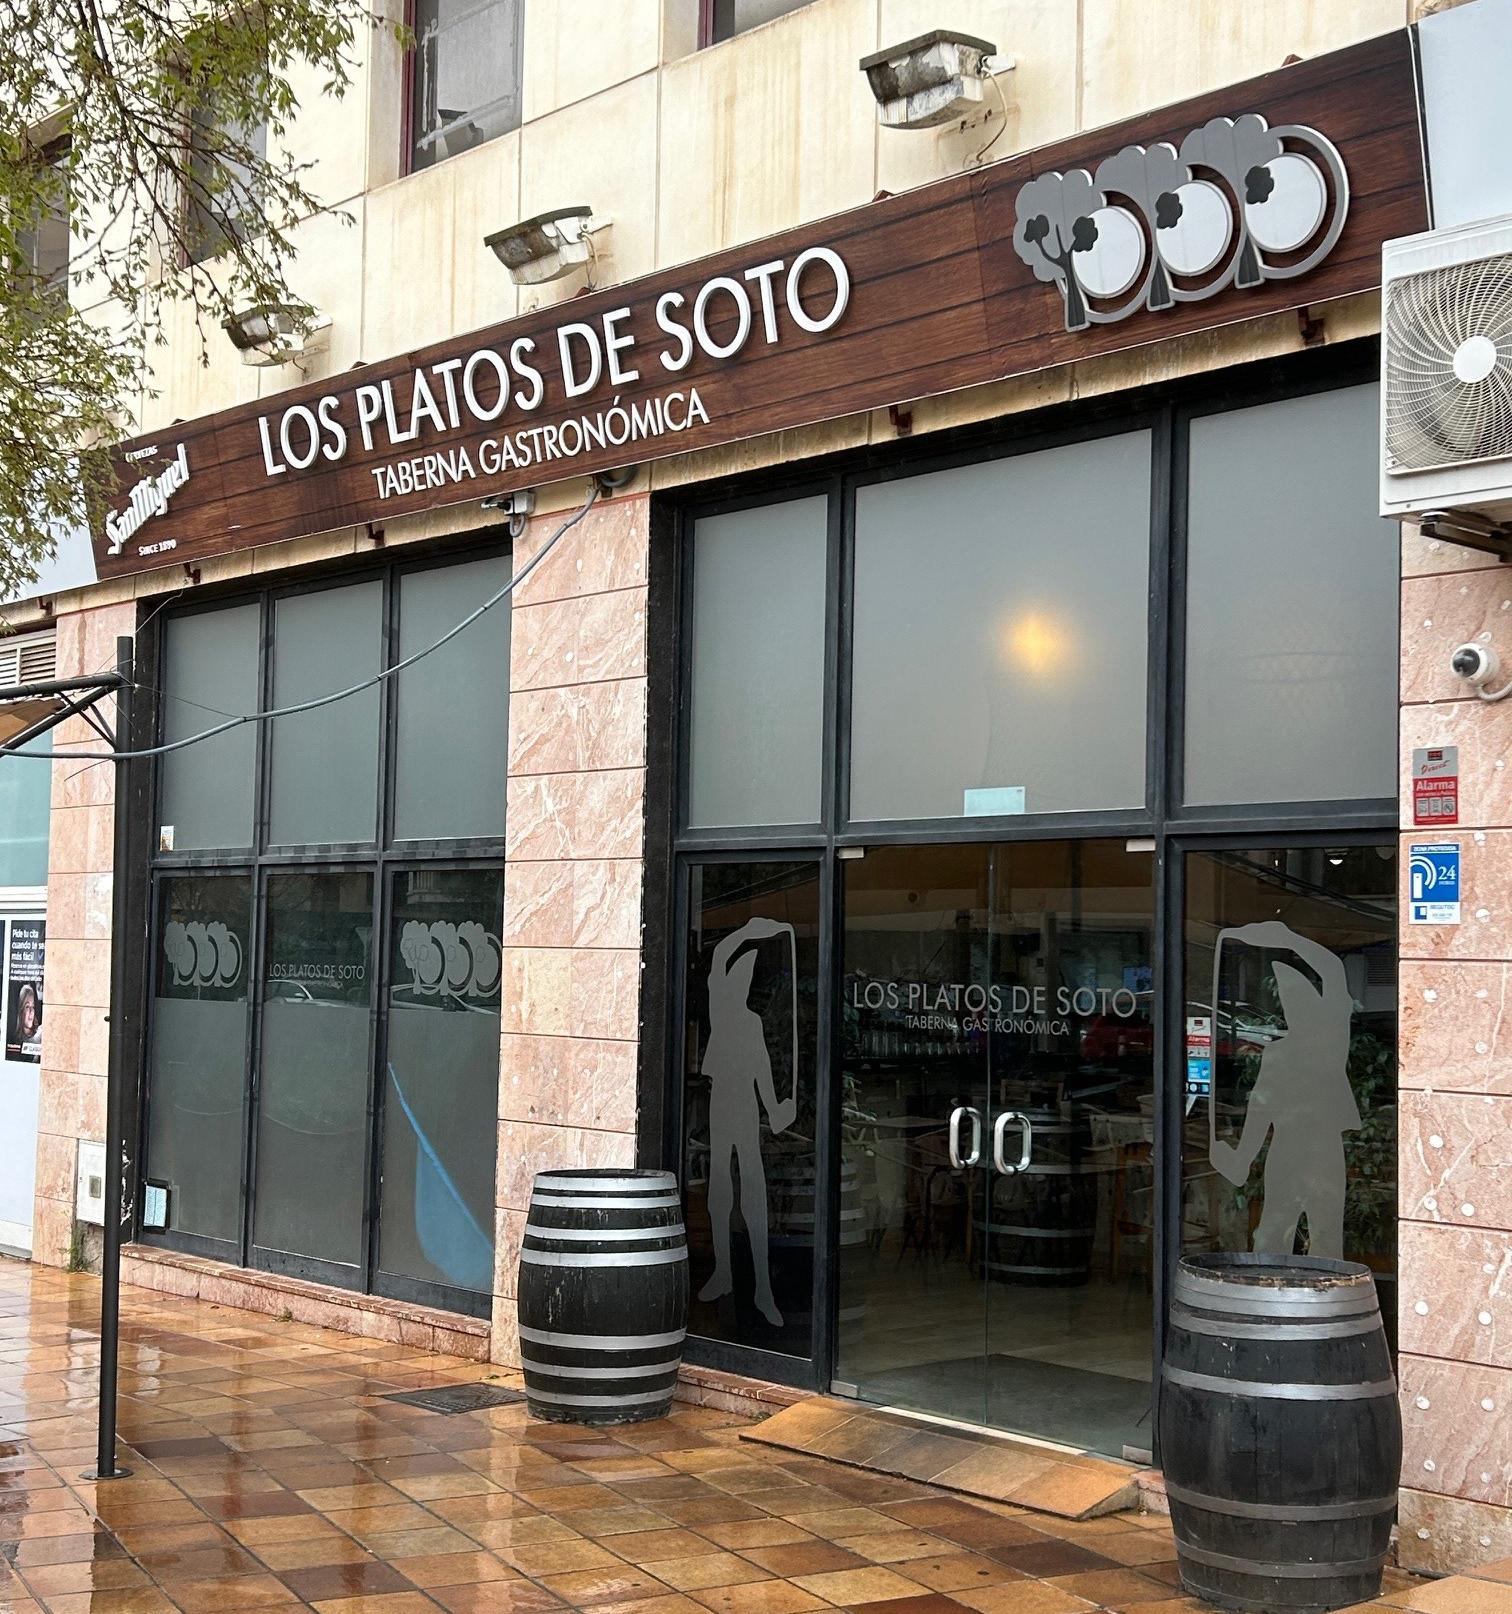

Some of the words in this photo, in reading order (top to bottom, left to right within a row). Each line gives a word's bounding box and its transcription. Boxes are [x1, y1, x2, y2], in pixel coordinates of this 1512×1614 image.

[259, 395, 347, 476] LOS
[356, 337, 544, 451] PLATOS
[557, 307, 639, 398] DE
[655, 247, 850, 371] SOTO
[371, 446, 476, 500] TABERNA
[478, 388, 710, 477] GASTRONÓMICA
[138, 543, 159, 557] SINCE
[1416, 780, 1455, 792] Alarma
[1437, 864, 1457, 880] 24
[12, 929, 23, 938] Pide
[23, 929, 29, 938] tu
[30, 929, 39, 938] cita
[11, 941, 31, 950] cuando
[32, 941, 37, 950] te
[11, 951, 22, 960] más
[269, 963, 287, 978] LOS
[288, 964, 321, 979] PLATOS
[323, 965, 336, 979] DE
[338, 965, 365, 980] SOTO
[853, 982, 900, 1010] LOS
[908, 983, 1001, 1014] PLATOS
[1012, 986, 1047, 1015] DE
[1056, 986, 1137, 1018] SOTO
[906, 1015, 958, 1031] TABERNA
[963, 1016, 1069, 1036] GASRONÓMICA
